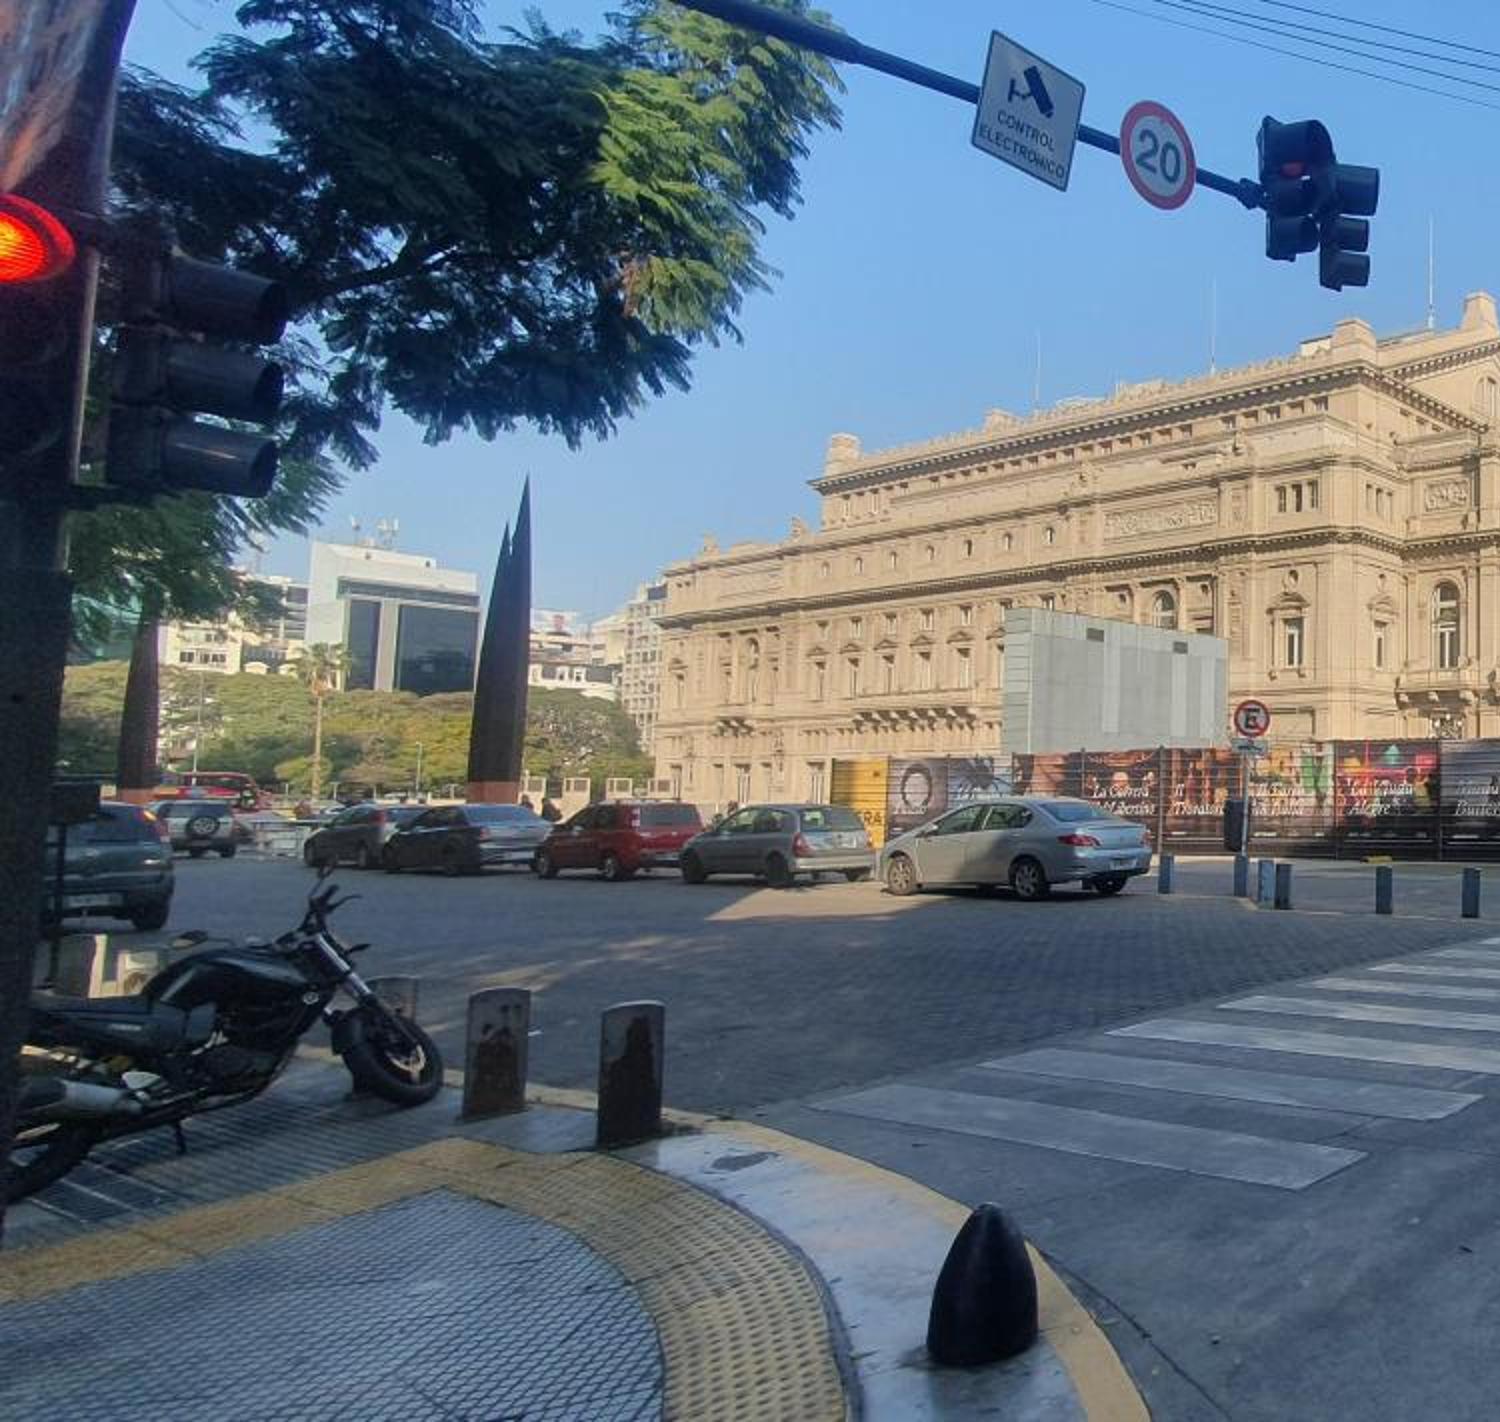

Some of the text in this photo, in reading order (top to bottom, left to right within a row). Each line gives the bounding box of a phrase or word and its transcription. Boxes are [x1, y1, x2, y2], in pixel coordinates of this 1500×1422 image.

[998, 109, 1055, 152] CONTROL
[1135, 129, 1181, 184] 20
[1244, 707, 1261, 729] E
